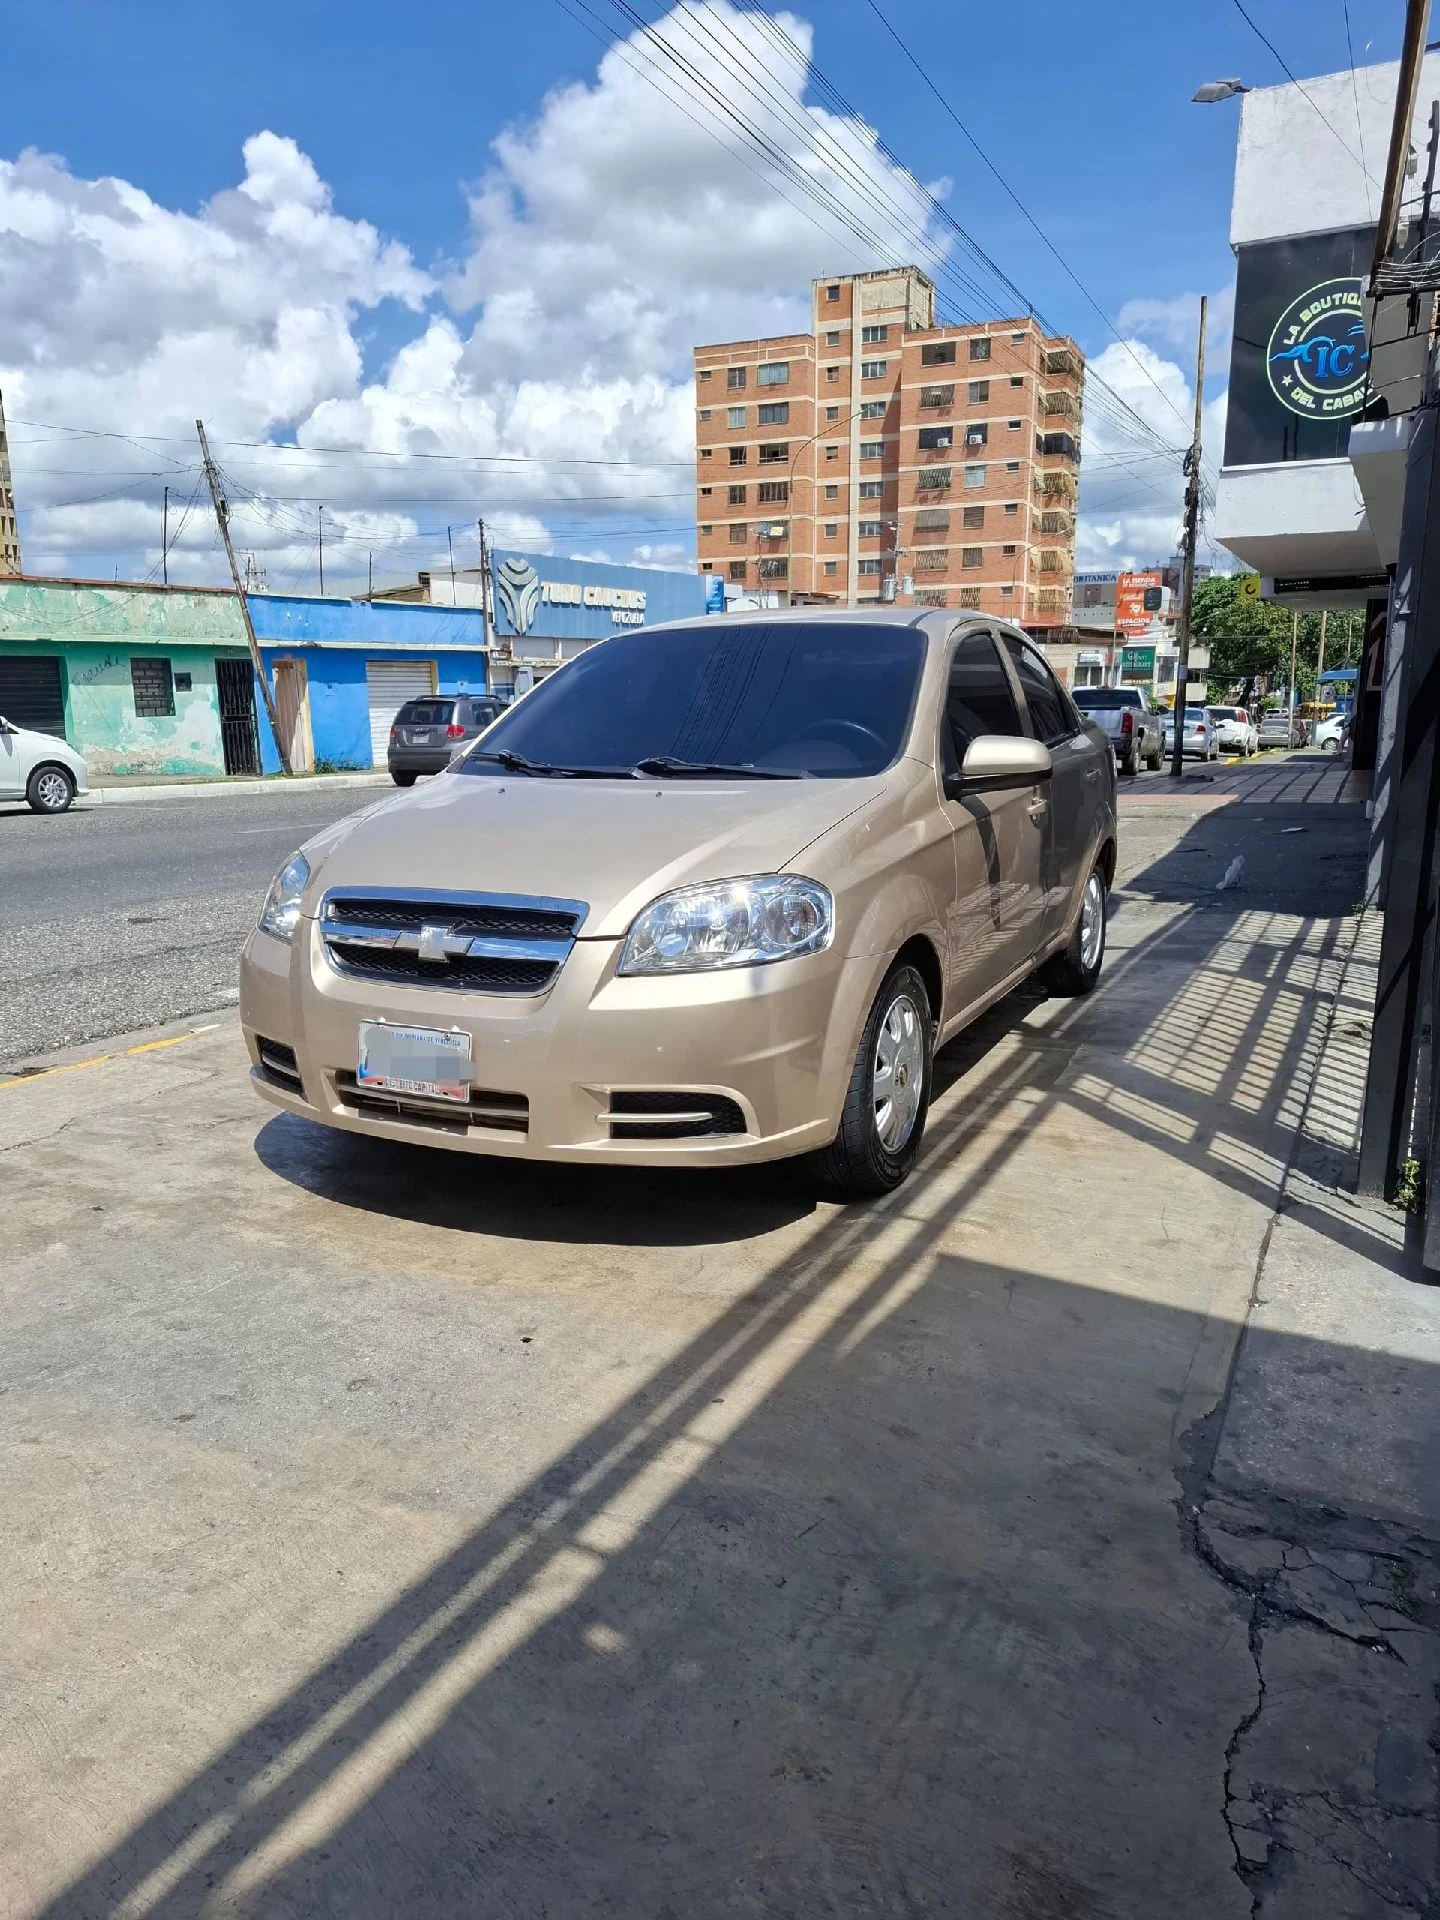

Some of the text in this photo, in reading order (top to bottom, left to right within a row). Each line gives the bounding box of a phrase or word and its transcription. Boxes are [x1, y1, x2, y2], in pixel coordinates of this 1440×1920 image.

[1283, 292, 1362, 345] LA BOUTIQ
[1290, 387, 1316, 409] DEL
